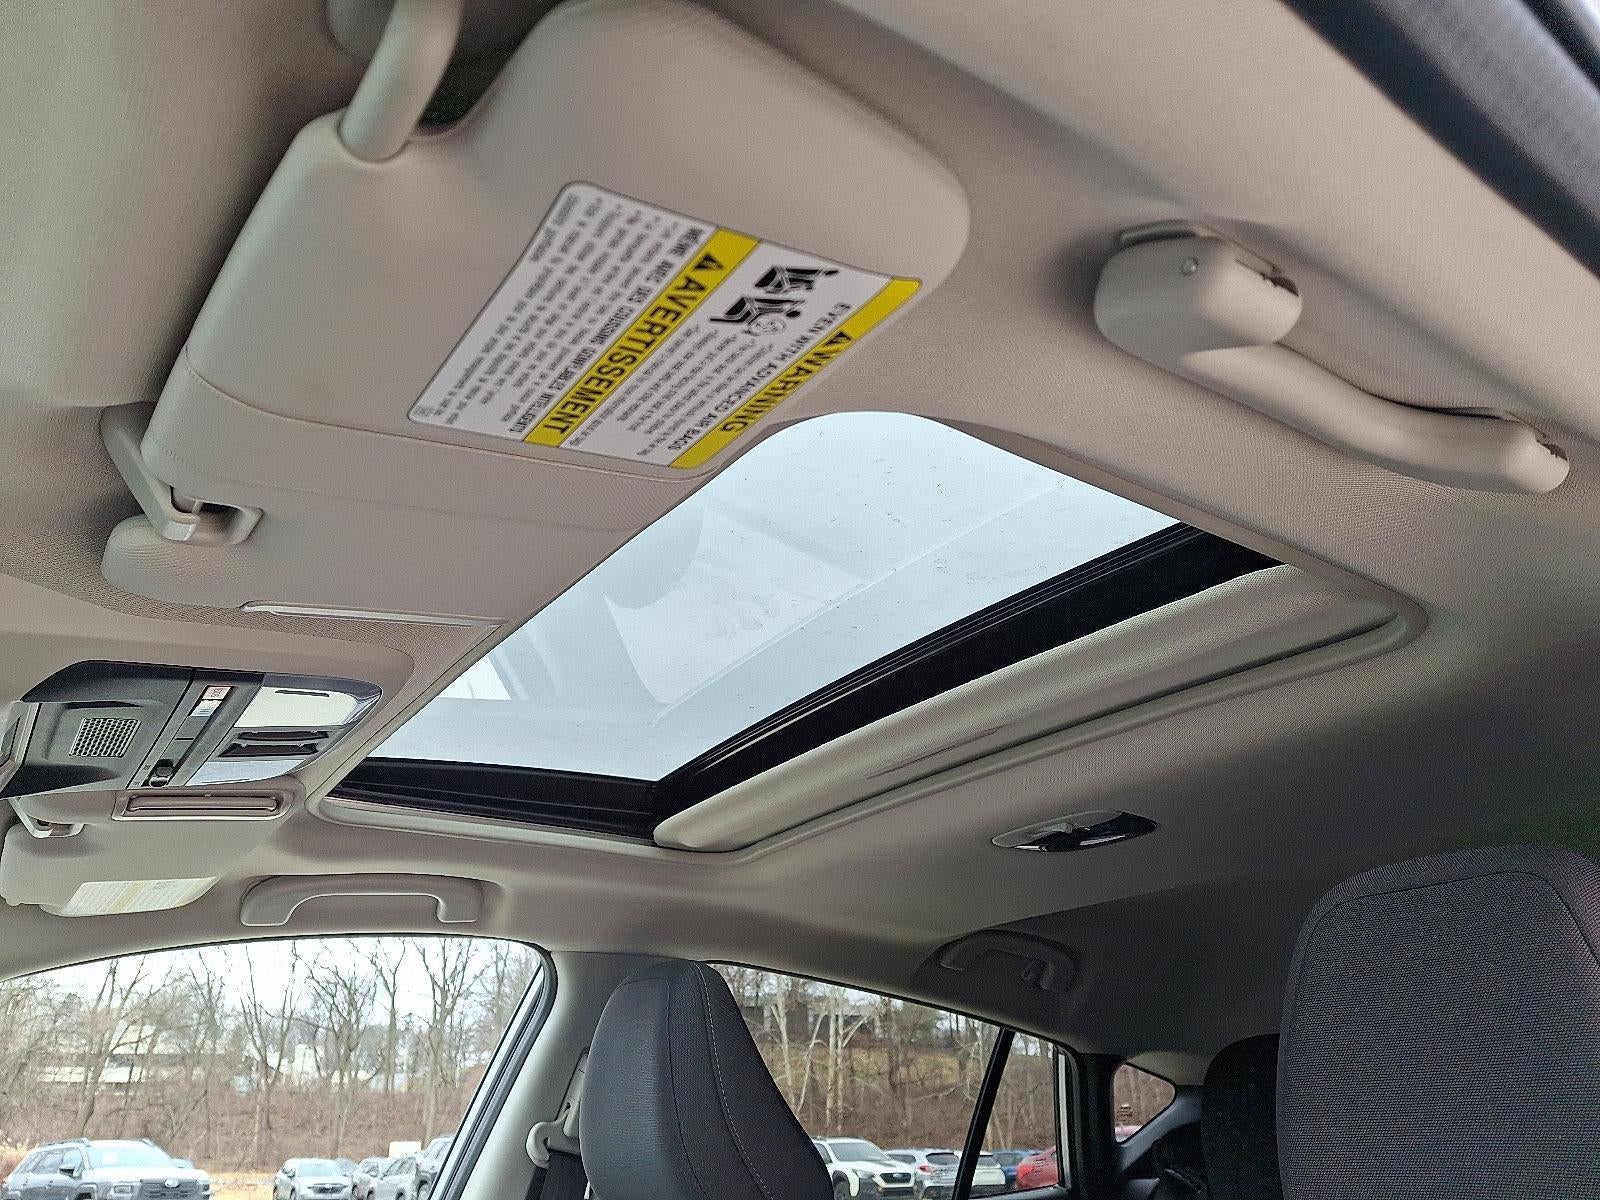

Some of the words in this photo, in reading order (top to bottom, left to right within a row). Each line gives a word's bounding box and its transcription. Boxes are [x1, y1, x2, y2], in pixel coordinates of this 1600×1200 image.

[807, 303, 852, 333] EVEN
[540, 276, 708, 434] AVERTISSEMENT
[773, 335, 811, 361] WITH
[714, 363, 778, 411] ADVANCED
[721, 349, 835, 433] WARNING
[666, 429, 701, 450] BAGS
